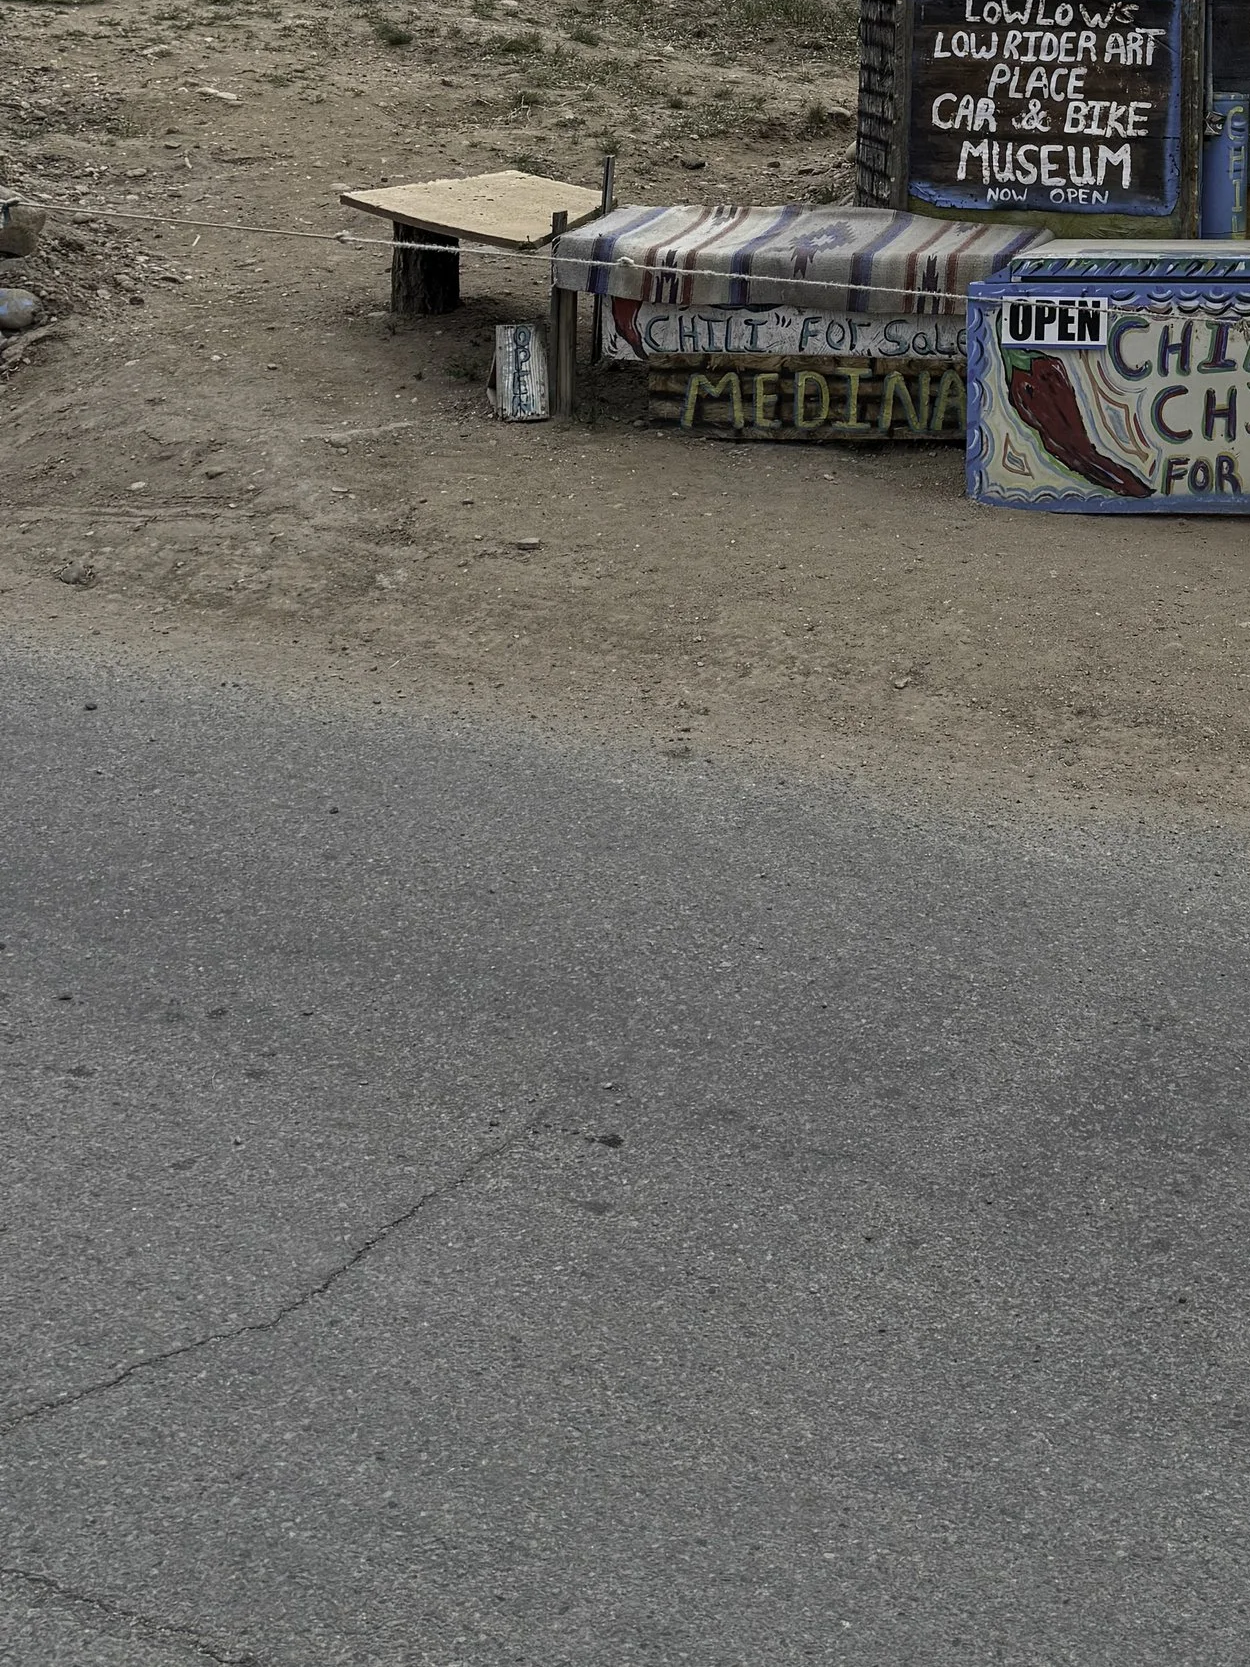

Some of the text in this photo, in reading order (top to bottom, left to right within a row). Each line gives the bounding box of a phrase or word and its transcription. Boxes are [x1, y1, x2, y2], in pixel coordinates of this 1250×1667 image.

[1104, 28, 1167, 66] ART
[987, 63, 1088, 102] PLACE
[932, 92, 1152, 138] CAR & BIKE
[956, 139, 1132, 189] MUSEUM
[986, 187, 1110, 205] NOW OPEN
[1008, 300, 1100, 342] OPEN
[681, 368, 968, 432] MEDINA
[1160, 451, 1243, 496] FOR
